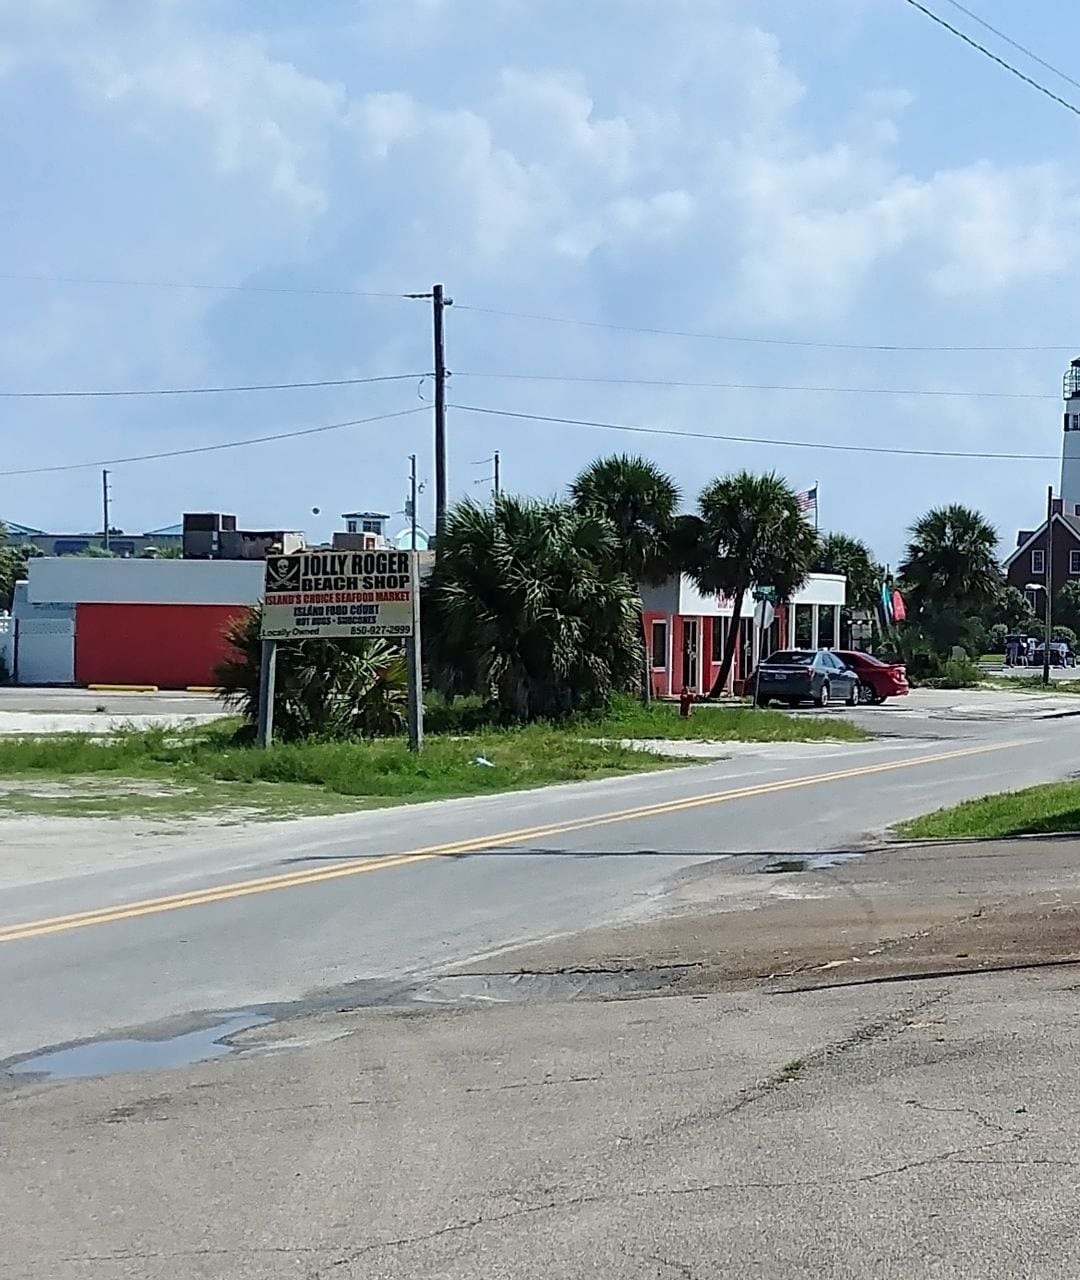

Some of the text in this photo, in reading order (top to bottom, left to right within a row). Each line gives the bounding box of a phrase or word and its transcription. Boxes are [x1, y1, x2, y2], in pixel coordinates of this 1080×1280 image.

[302, 552, 409, 576] JOLLY ROGER
[302, 575, 410, 591] BEACH SHOP
[265, 591, 410, 605] ISLAND'S CHOICE SEAFOOD MARKET
[294, 604, 380, 616] ISLAND FOOD COURT
[262, 628, 290, 637] Locally
[292, 628, 320, 636] Owned
